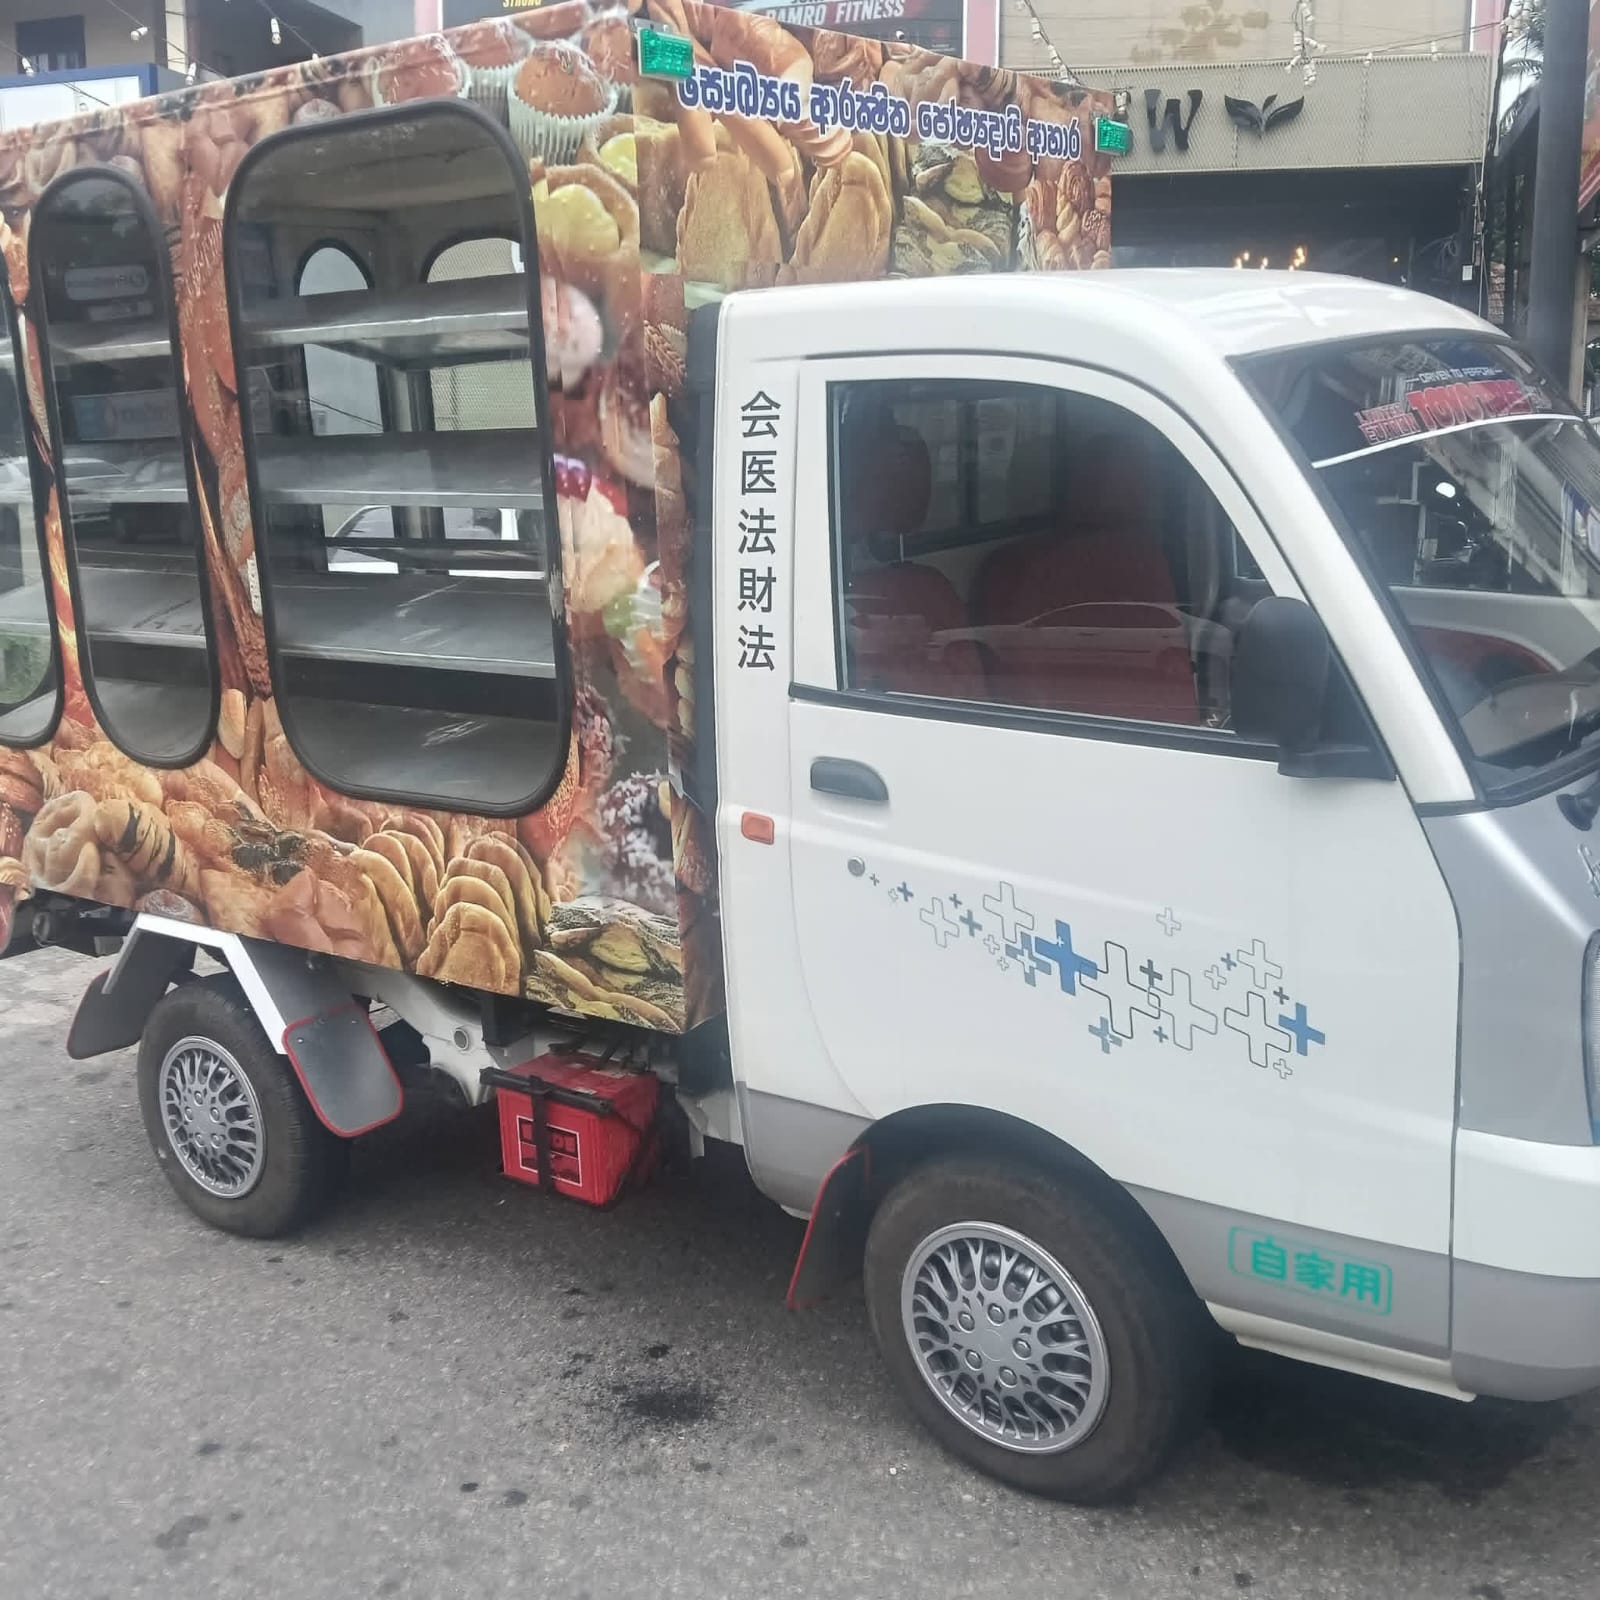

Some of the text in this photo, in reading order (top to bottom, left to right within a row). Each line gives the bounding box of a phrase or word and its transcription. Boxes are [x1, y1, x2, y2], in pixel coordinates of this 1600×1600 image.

[836, 0, 906, 24] FITNESS
[1026, 116, 1081, 164] ආහාර
[737, 390, 782, 672] 会医法財法
[1251, 1235, 1381, 1306] 自家用
